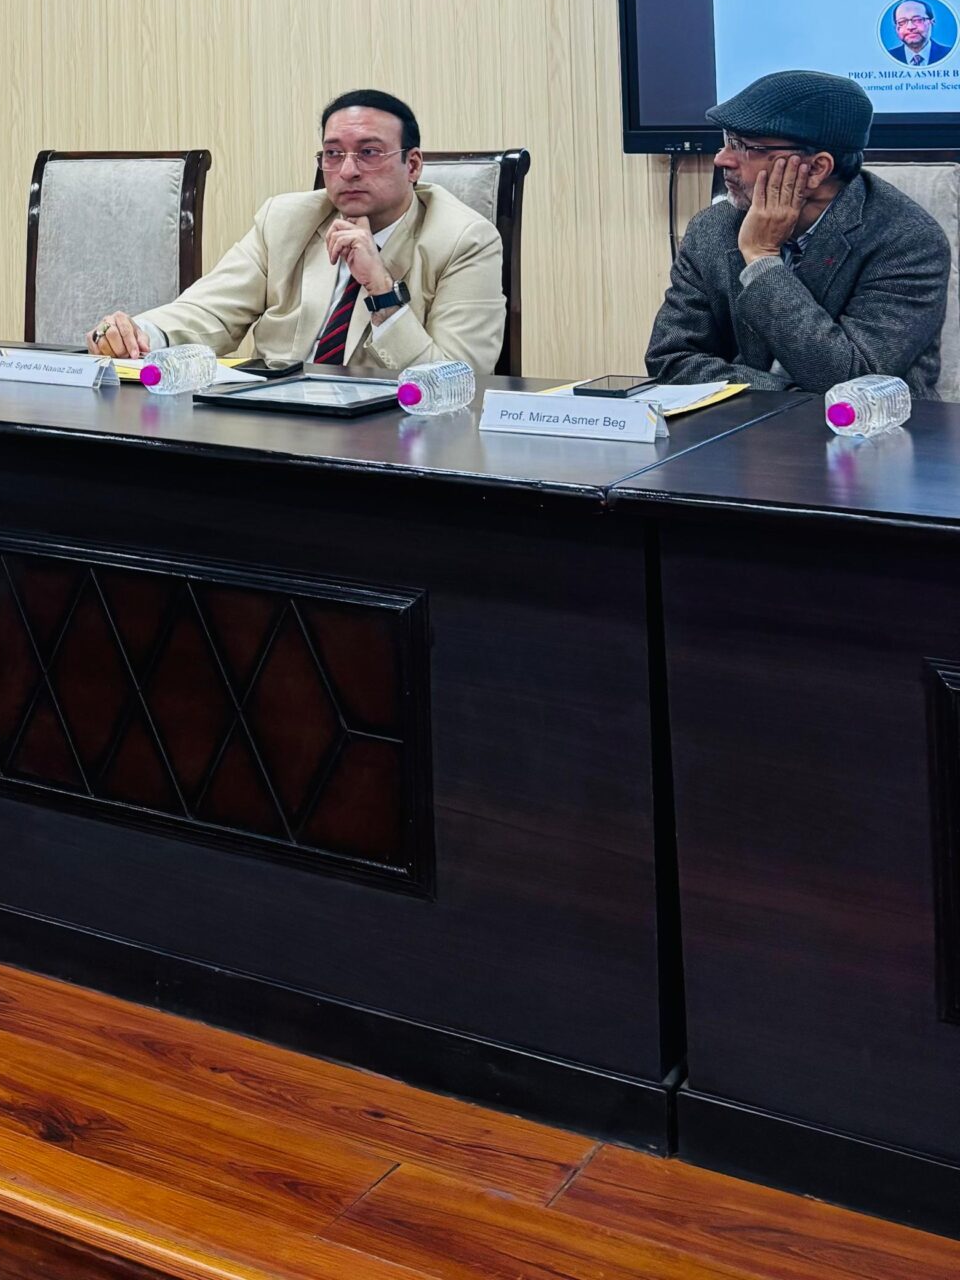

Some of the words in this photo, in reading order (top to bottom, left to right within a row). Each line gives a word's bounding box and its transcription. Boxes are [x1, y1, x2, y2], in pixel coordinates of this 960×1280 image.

[848, 71, 877, 79] PROF.
[879, 71, 911, 79] MIRZA
[914, 70, 950, 78] ASMER
[895, 82, 903, 91] of
[906, 82, 938, 91] Political
[500, 410, 525, 421] Prof.
[528, 412, 559, 423] Mirza
[562, 414, 600, 426] Asmer
[602, 416, 626, 429] Beg
